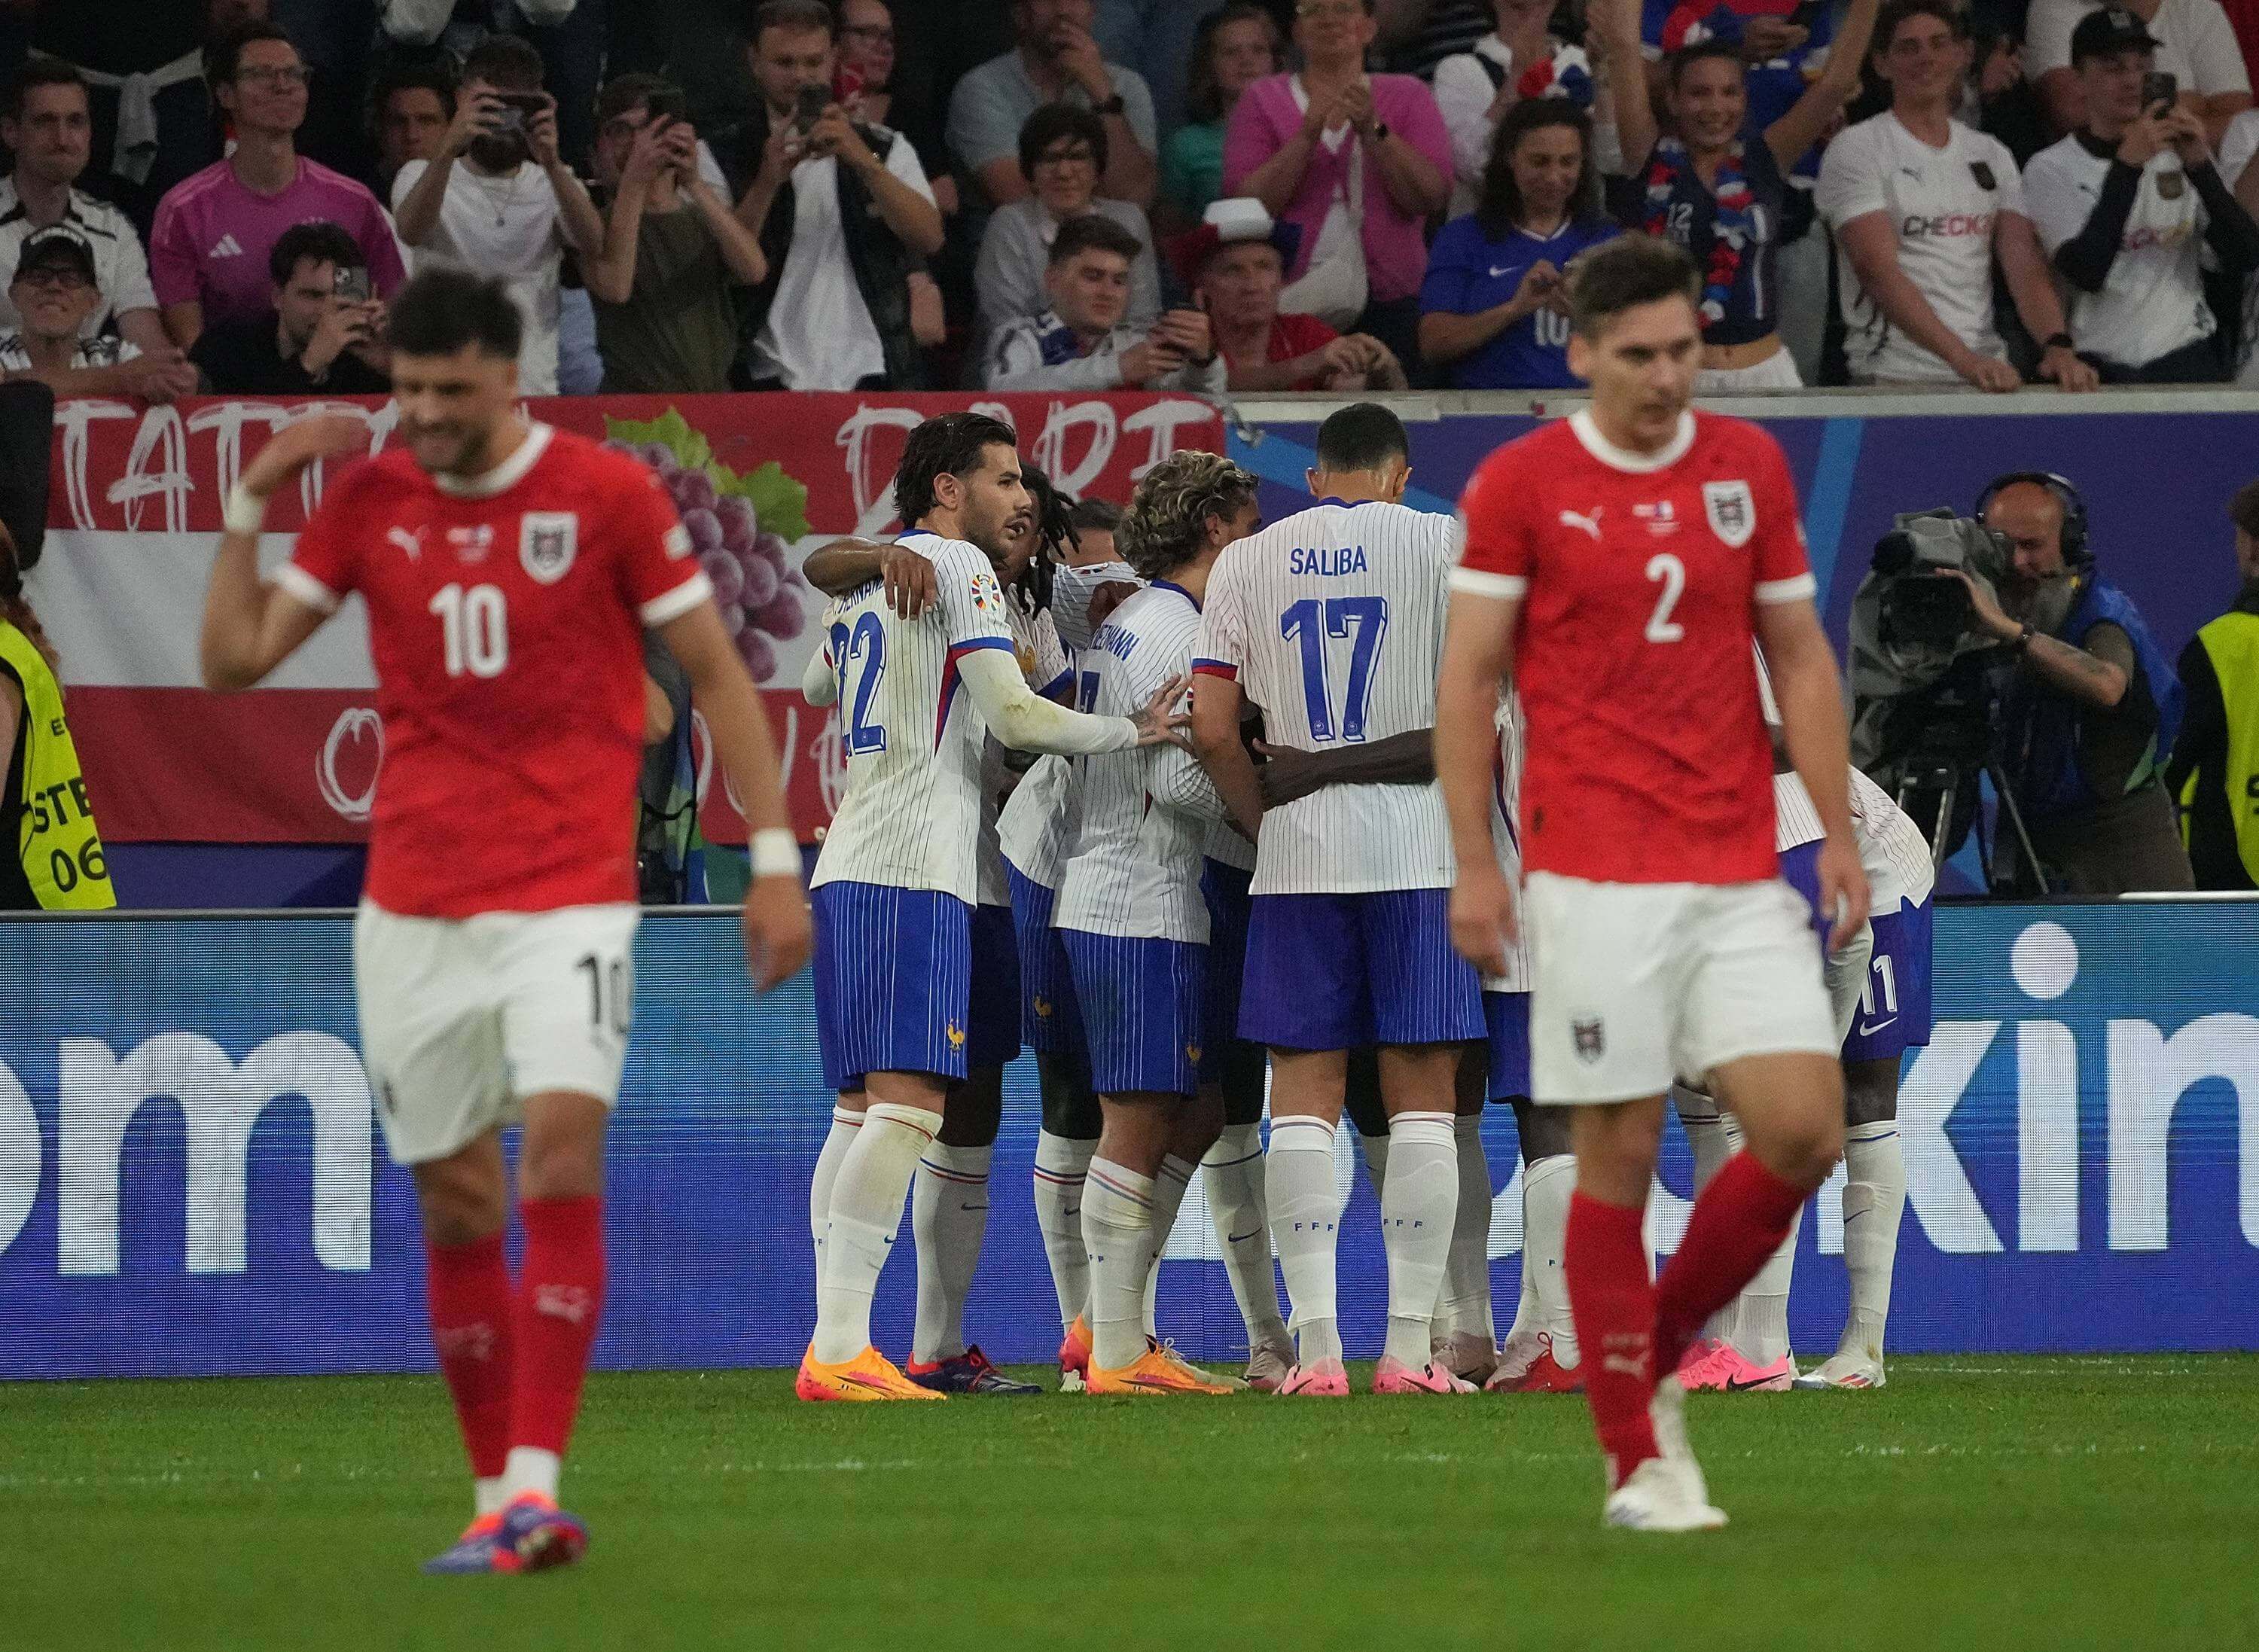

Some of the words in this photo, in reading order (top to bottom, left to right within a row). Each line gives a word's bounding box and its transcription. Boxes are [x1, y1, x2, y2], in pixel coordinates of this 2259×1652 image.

[1289, 544, 1367, 577] SALIBA
[1645, 553, 1685, 643] 2
[428, 581, 509, 678] 10
[1280, 596, 1389, 742] 17
[830, 611, 886, 757] 22
[50, 835, 108, 893] 06
[1861, 954, 1898, 1016] 11
